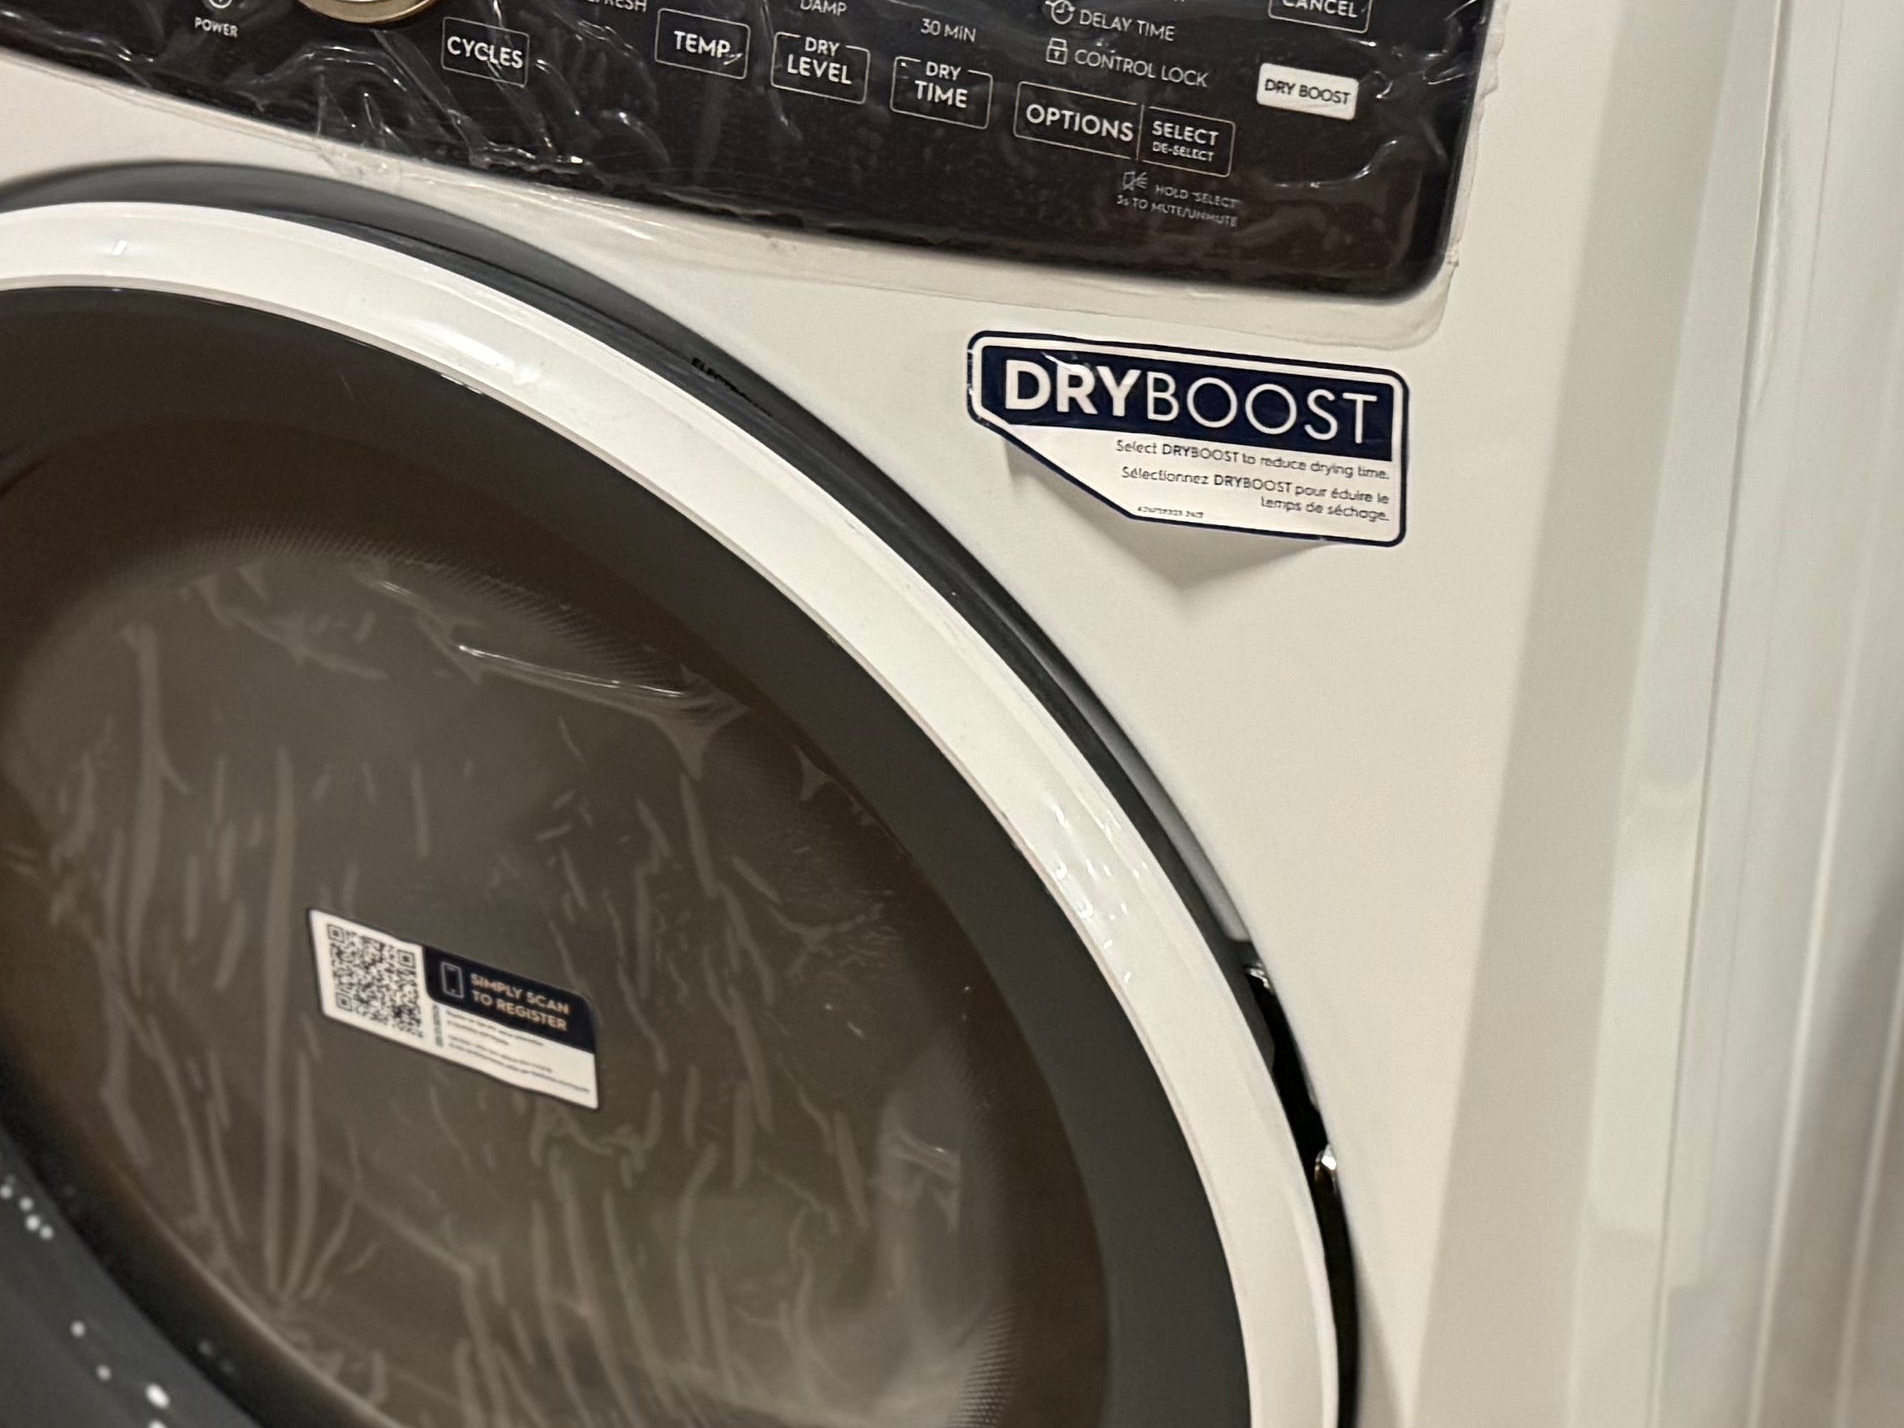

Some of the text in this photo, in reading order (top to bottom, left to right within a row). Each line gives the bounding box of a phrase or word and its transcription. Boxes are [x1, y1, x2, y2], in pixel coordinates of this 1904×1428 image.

[194, 16, 239, 39] POWER
[920, 18, 978, 43] 30 MIN
[1079, 9, 1177, 42] DELAY TIME
[446, 35, 525, 69] CYCLES
[673, 30, 732, 60] TEMP
[804, 36, 841, 58] DRY
[786, 53, 853, 86] LEVEL
[924, 61, 963, 82] DRY
[1073, 49, 1210, 88] CONTROL LOCK
[914, 79, 969, 109] TIME
[1263, 78, 1351, 107] DRY BOOST
[1025, 103, 1135, 143] OPTIONS
[1151, 120, 1220, 148] SELECT
[1151, 141, 1216, 163] DE-SELECT
[1132, 197, 1149, 210] TO
[1154, 183, 1190, 200] HOLD
[1004, 358, 1379, 445] DRYBOOST
[1116, 439, 1391, 481] Select DRYBOOST to reduce drying time.
[1121, 465, 1211, 486] Sélectionnez
[1213, 474, 1293, 494] DRYBOOST
[1295, 485, 1328, 498] pour
[1377, 492, 1390, 505] le
[1260, 496, 1303, 514] temps
[1305, 502, 1324, 515] de
[470, 972, 571, 1015] SIMPLY SCAN
[471, 989, 494, 1007] TO
[496, 997, 568, 1032] REGISTER
